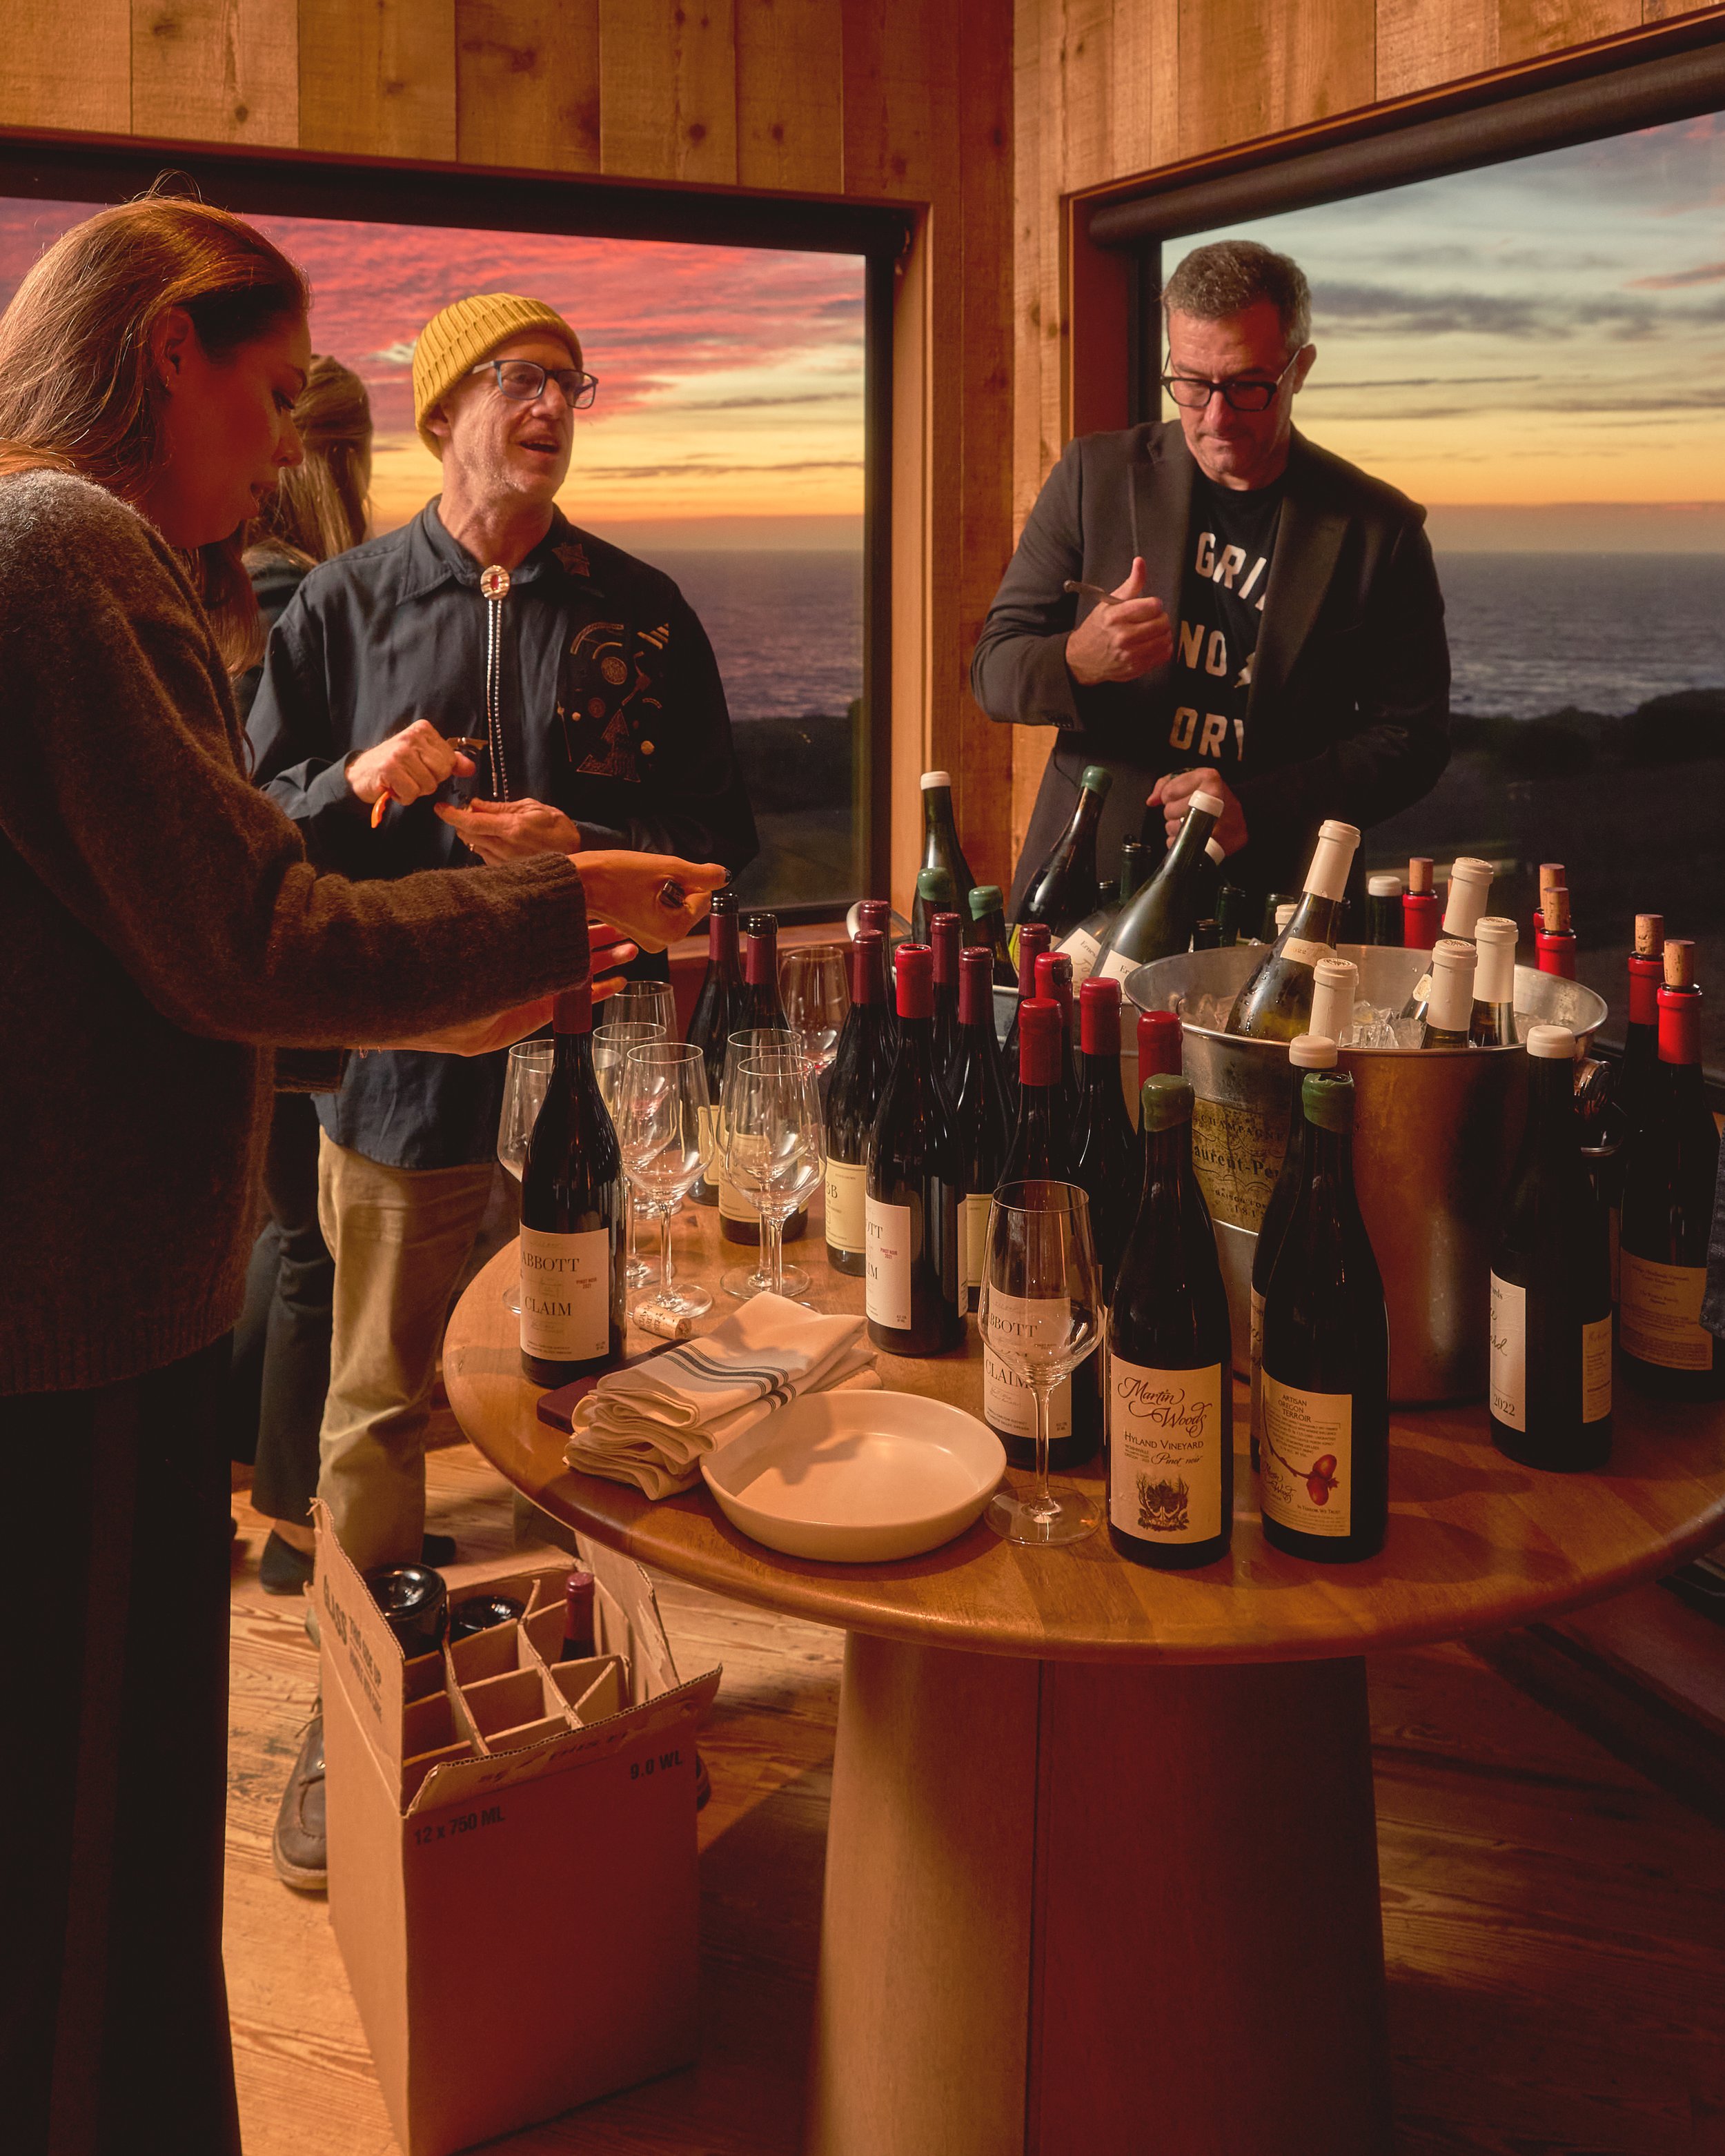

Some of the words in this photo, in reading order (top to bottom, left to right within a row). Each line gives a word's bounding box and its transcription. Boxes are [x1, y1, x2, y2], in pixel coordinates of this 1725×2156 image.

[1177, 620, 1228, 677] NO
[1201, 1115, 1286, 1140] CHAMPAGNE
[521, 1250, 580, 1272] ABBOTT
[524, 1296, 572, 1316] CLAIM
[1118, 1376, 1185, 1405] Martin
[1282, 1394, 1308, 1407] ARTISAN
[1278, 1400, 1304, 1414] OREGON
[1282, 1409, 1312, 1423] TERROIR
[1494, 1394, 1516, 1416] 2022
[1128, 1401, 1213, 1438] Woods
[1125, 1431, 1158, 1449] HYLAND
[1160, 1440, 1204, 1450] VINEYARD
[1151, 1452, 1183, 1467] Pinot
[1185, 1455, 1203, 1464] noir
[323, 1574, 348, 1646] GLASS
[630, 1758, 655, 1780] 9.0
[414, 1827, 433, 1846] 12
[436, 1828, 446, 1841] x
[449, 1812, 478, 1837] 750
[481, 1805, 507, 1828] ML
